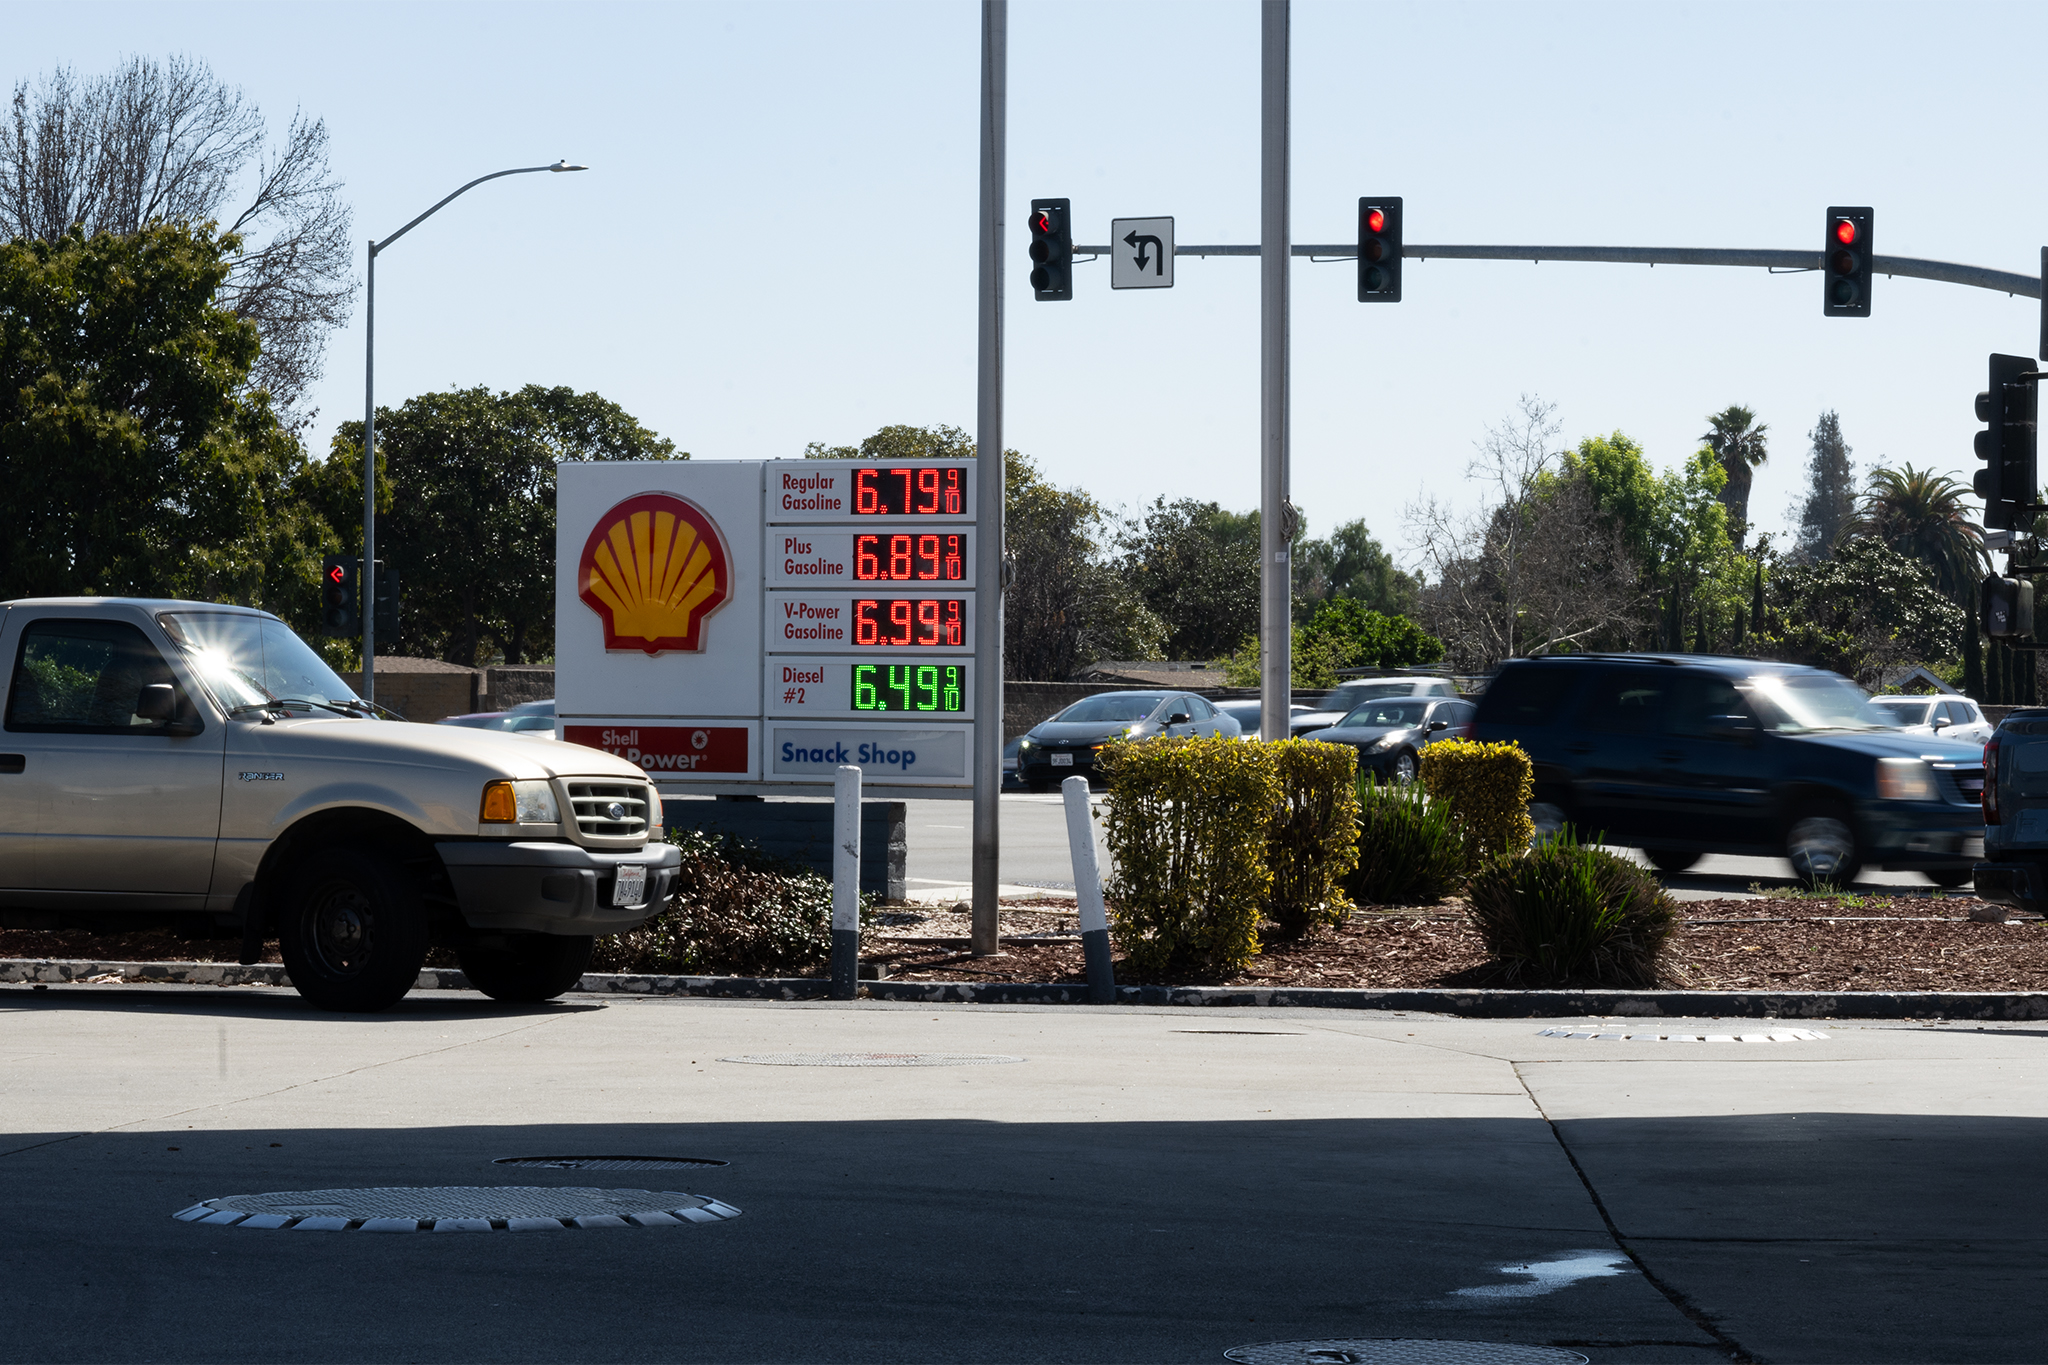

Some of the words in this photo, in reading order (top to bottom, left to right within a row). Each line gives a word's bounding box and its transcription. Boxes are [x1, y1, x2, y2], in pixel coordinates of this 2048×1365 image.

[783, 472, 834, 494] Regular
[947, 469, 958, 489] 9
[782, 493, 841, 510] Gasoline
[857, 469, 940, 514] 6.79
[945, 492, 960, 514] 10
[785, 538, 812, 554] Plus
[947, 535, 958, 556] 9
[784, 558, 843, 575] Gasoline
[857, 535, 940, 580] 6.89
[946, 558, 960, 580] 10
[784, 602, 840, 619] V-Power
[948, 601, 958, 621] 9
[784, 623, 843, 640] Gasoline
[857, 600, 940, 646] 6.99
[946, 624, 960, 646] 10
[783, 666, 824, 683] Diesel
[946, 666, 957, 687] 9
[783, 688, 805, 704] #2
[855, 665, 938, 710] 6.49
[944, 690, 959, 710] 10
[602, 730, 638, 746] Shell
[781, 741, 850, 763] Snack
[858, 742, 916, 770] Shop
[238, 771, 285, 782] RANGER
